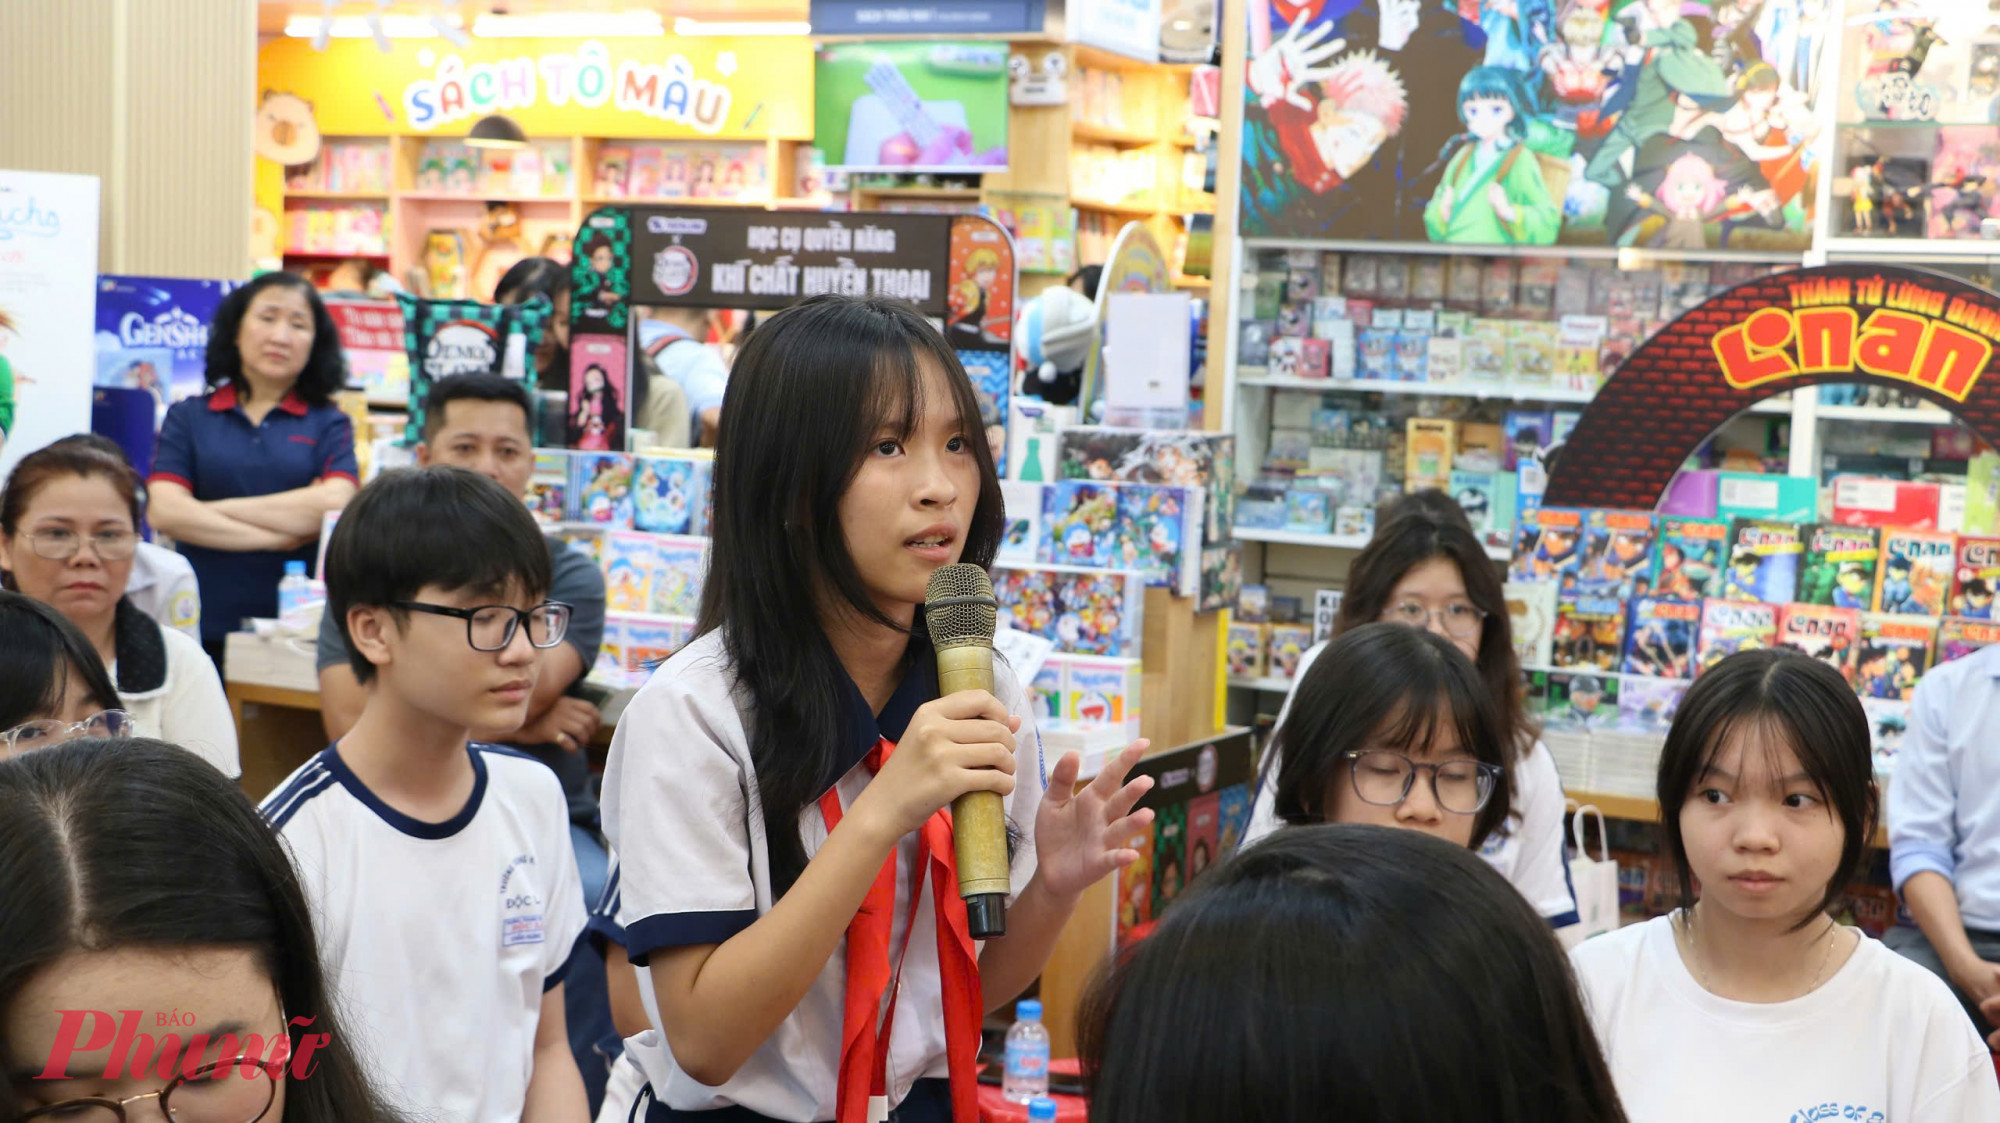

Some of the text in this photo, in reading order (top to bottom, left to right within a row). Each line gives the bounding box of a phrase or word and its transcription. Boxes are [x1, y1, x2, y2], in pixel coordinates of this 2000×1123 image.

[411, 49, 723, 125] SÁCH TÔ MÀU
[803, 220, 851, 251] QUYỀN
[853, 224, 896, 253] NĂNG
[711, 258, 752, 294] KHÍ
[749, 255, 799, 295] CHẤT
[802, 256, 868, 297] HUYỀN
[870, 267, 931, 304] THOẠI
[119, 311, 209, 347] GENSHI
